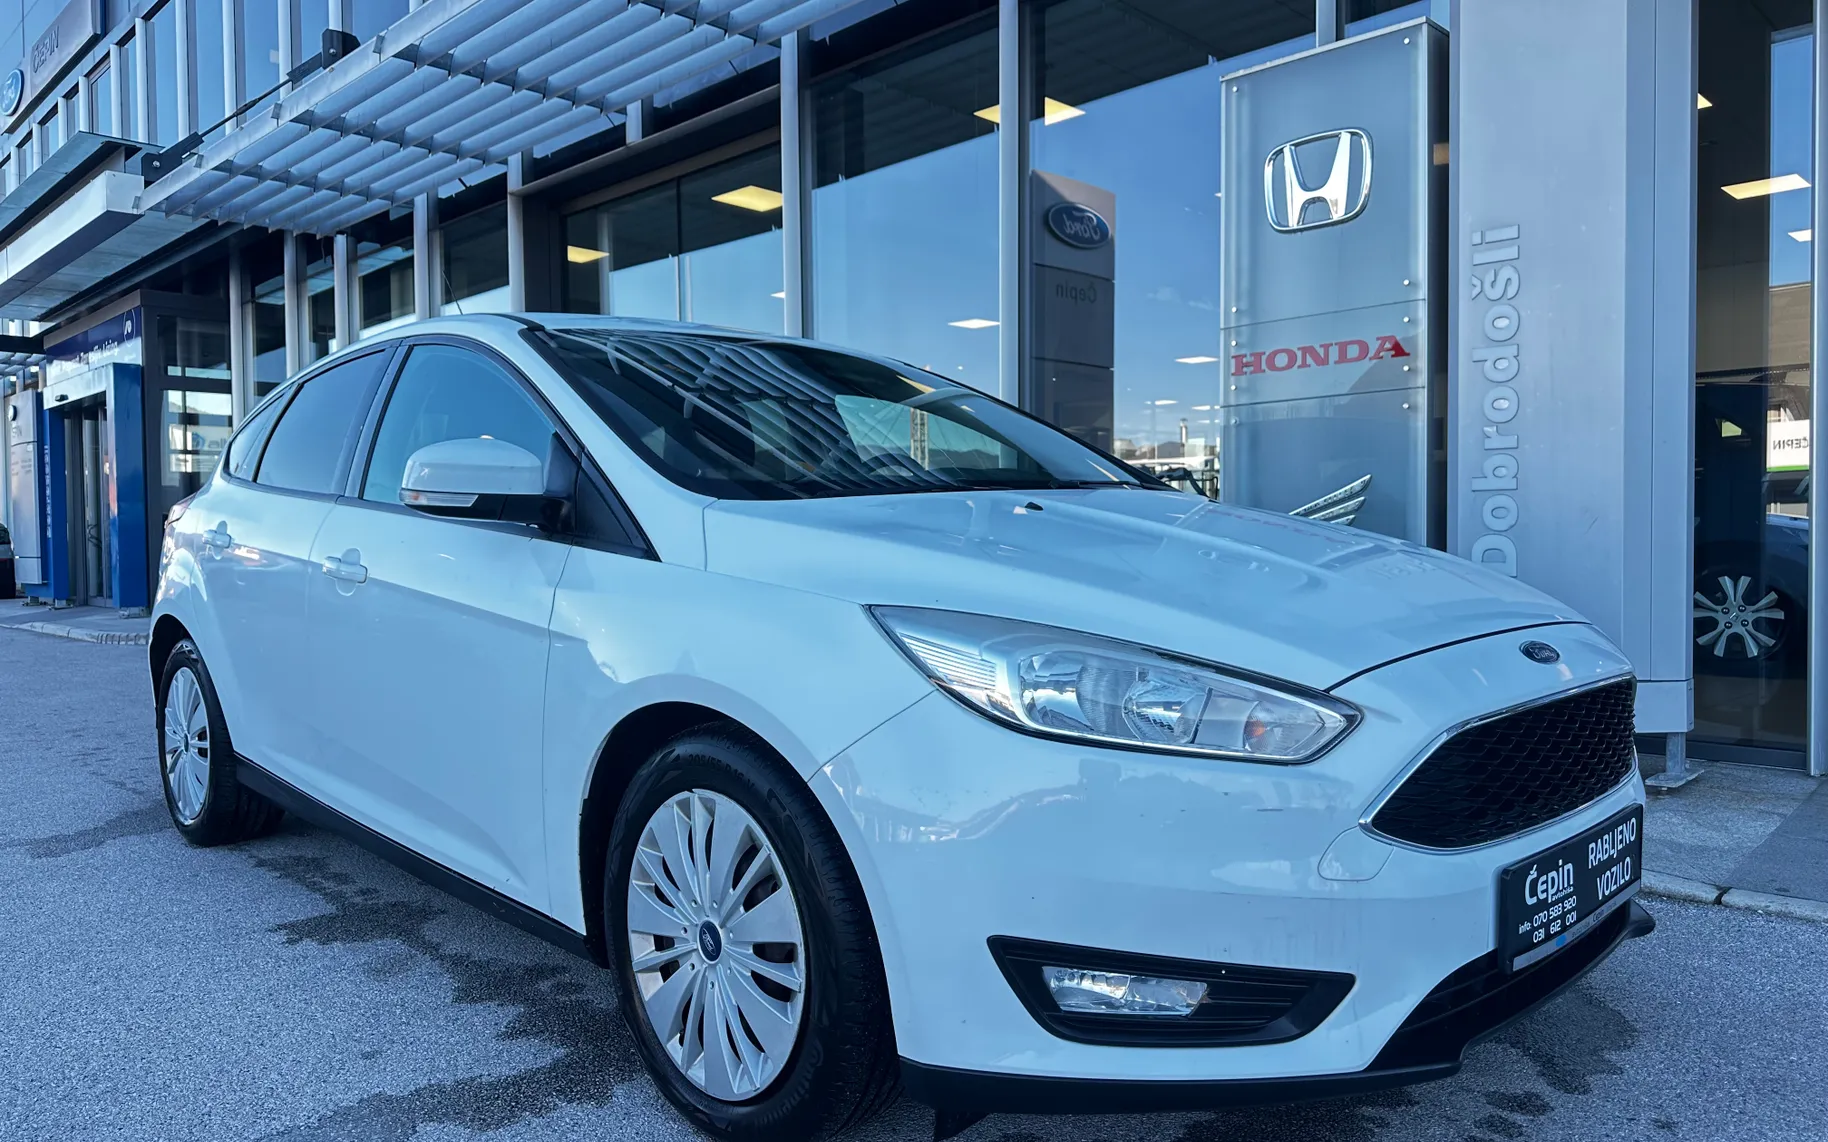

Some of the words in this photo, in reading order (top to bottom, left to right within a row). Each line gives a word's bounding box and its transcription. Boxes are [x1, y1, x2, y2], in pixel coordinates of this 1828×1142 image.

[1231, 335, 1411, 376] HONDA
[1471, 224, 1521, 578] Dobrodošli
[1588, 817, 1636, 869] RABLJENO
[1525, 859, 1573, 905] Čepin
[1596, 856, 1631, 900] VOZILO
[1533, 910, 1548, 927] 070
[1549, 903, 1562, 919] 583
[1563, 895, 1577, 912] 920
[1533, 927, 1545, 943] 031
[1549, 919, 1562, 934] 612
[1565, 910, 1577, 926] 001
